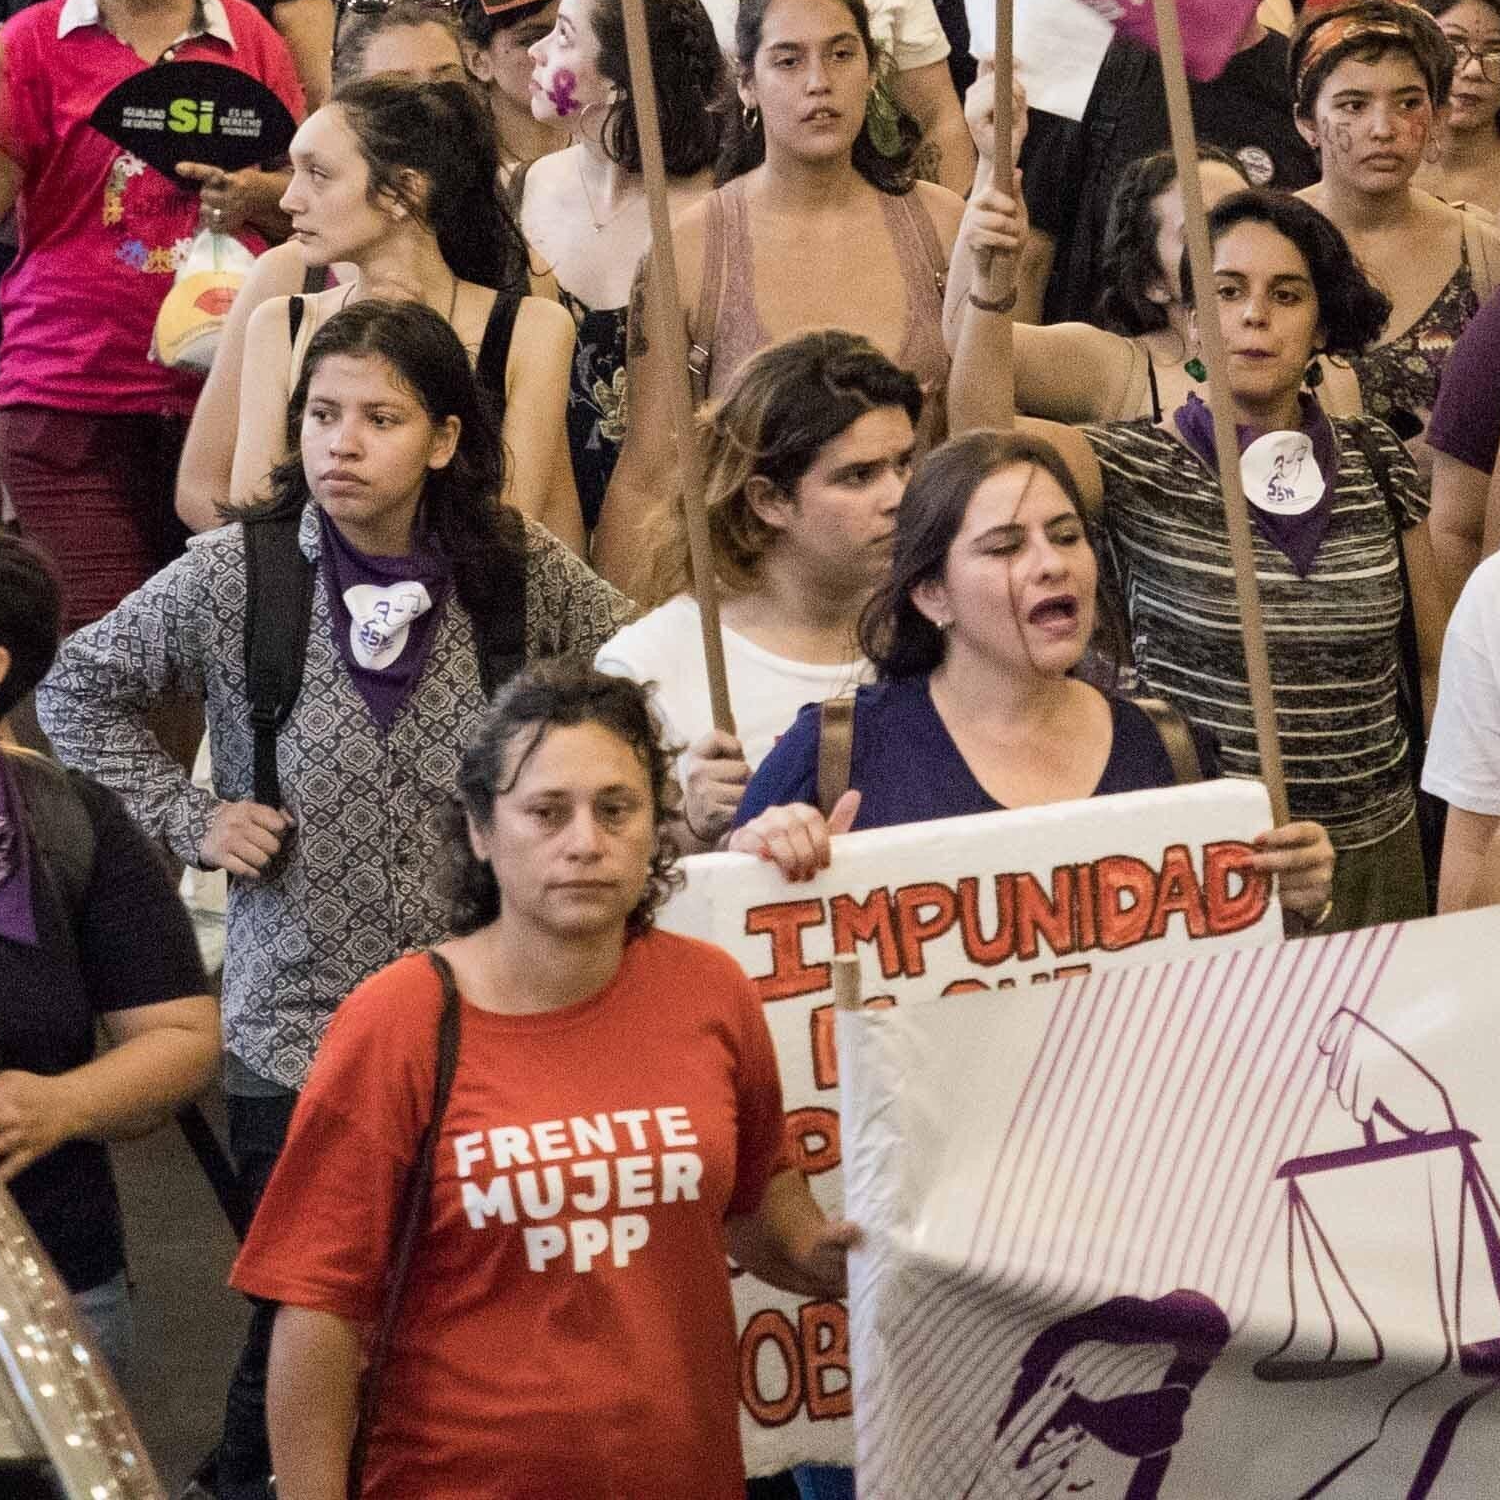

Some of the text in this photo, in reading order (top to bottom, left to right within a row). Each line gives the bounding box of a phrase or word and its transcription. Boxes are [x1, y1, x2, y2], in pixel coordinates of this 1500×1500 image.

[745, 839, 1274, 1002] IMPUNIDAD
[453, 1105, 698, 1179] FRENTE
[460, 1151, 704, 1230] MUJER
[522, 1213, 651, 1274] PPP
